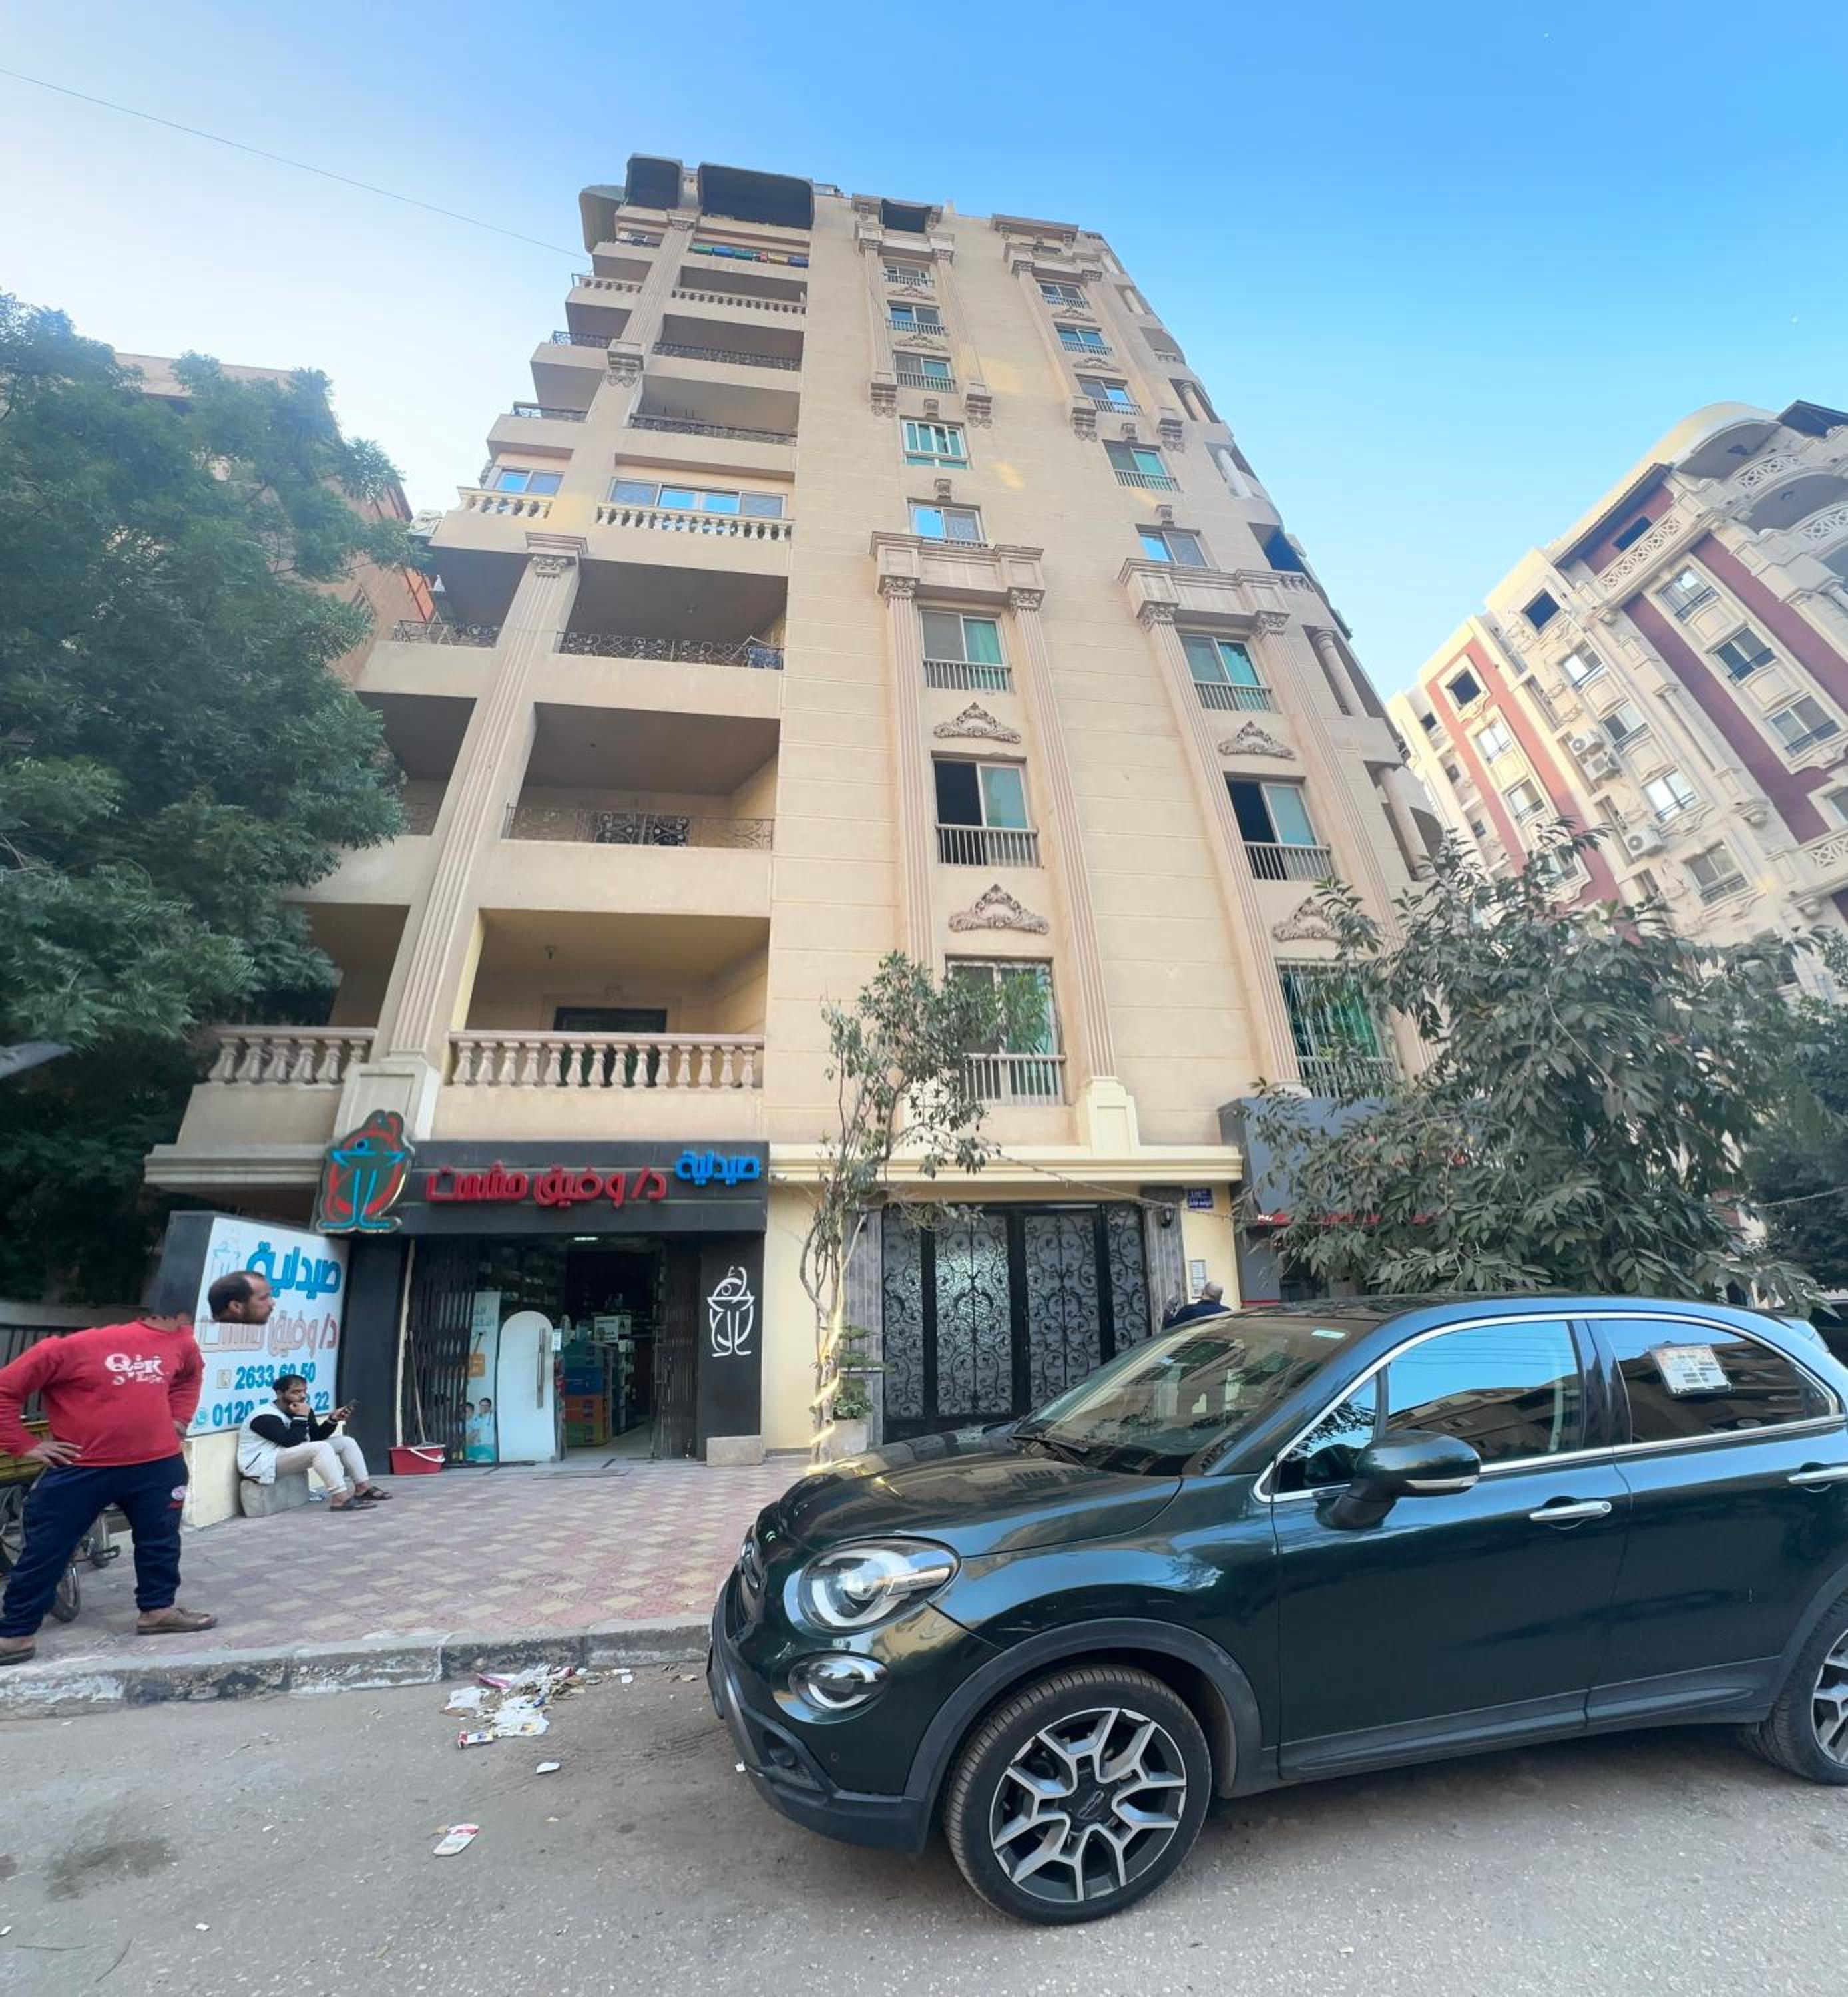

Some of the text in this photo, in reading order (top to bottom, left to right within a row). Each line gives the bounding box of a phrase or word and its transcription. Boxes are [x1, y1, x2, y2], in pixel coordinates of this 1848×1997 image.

[533, 1163, 624, 1208] وفيق
[675, 1149, 760, 1186] صيدلية
[246, 1241, 342, 1299] صيدلية
[234, 1365, 274, 1390] 2633
[301, 1362, 316, 1383] 50
[314, 1391, 330, 1411] 22
